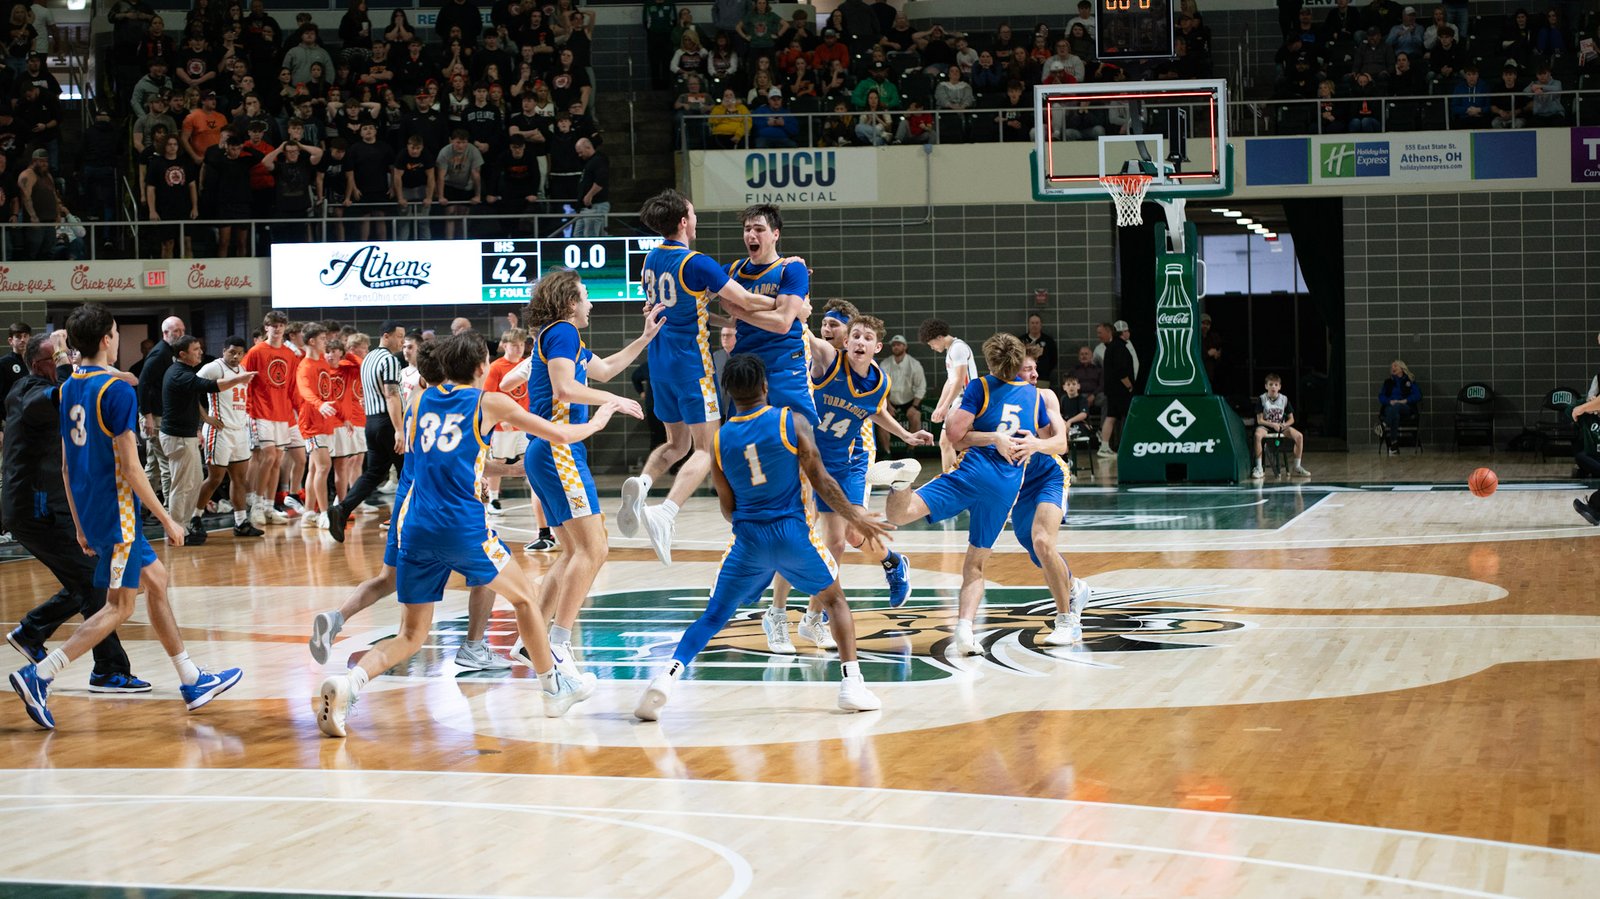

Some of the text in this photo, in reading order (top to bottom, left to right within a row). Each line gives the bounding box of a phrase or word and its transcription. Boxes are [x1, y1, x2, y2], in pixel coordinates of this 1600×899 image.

[1356, 147, 1389, 157] Holiday Inn
[1357, 156, 1388, 167] Express
[1400, 152, 1463, 164] Athens, OH
[745, 151, 836, 189] OUCU
[745, 191, 837, 203] FINANCIAL
[494, 242, 515, 252] IHS
[564, 244, 606, 268] 0.0
[147, 271, 166, 286] EXIT
[319, 245, 432, 289] Athens
[492, 257, 527, 283] 42
[70, 269, 136, 293] Chick-fil-A
[187, 268, 253, 292] Chick-fil-A
[644, 269, 677, 308] 30
[489, 287, 531, 298] 5 FOULS
[1467, 386, 1486, 399] OHIO
[1551, 390, 1572, 405] OHIO
[69, 404, 87, 446] 3
[419, 411, 466, 453] 35
[817, 411, 852, 439] 14
[996, 403, 1023, 437] 5
[1133, 438, 1216, 457] gomart
[743, 443, 768, 487] 1
